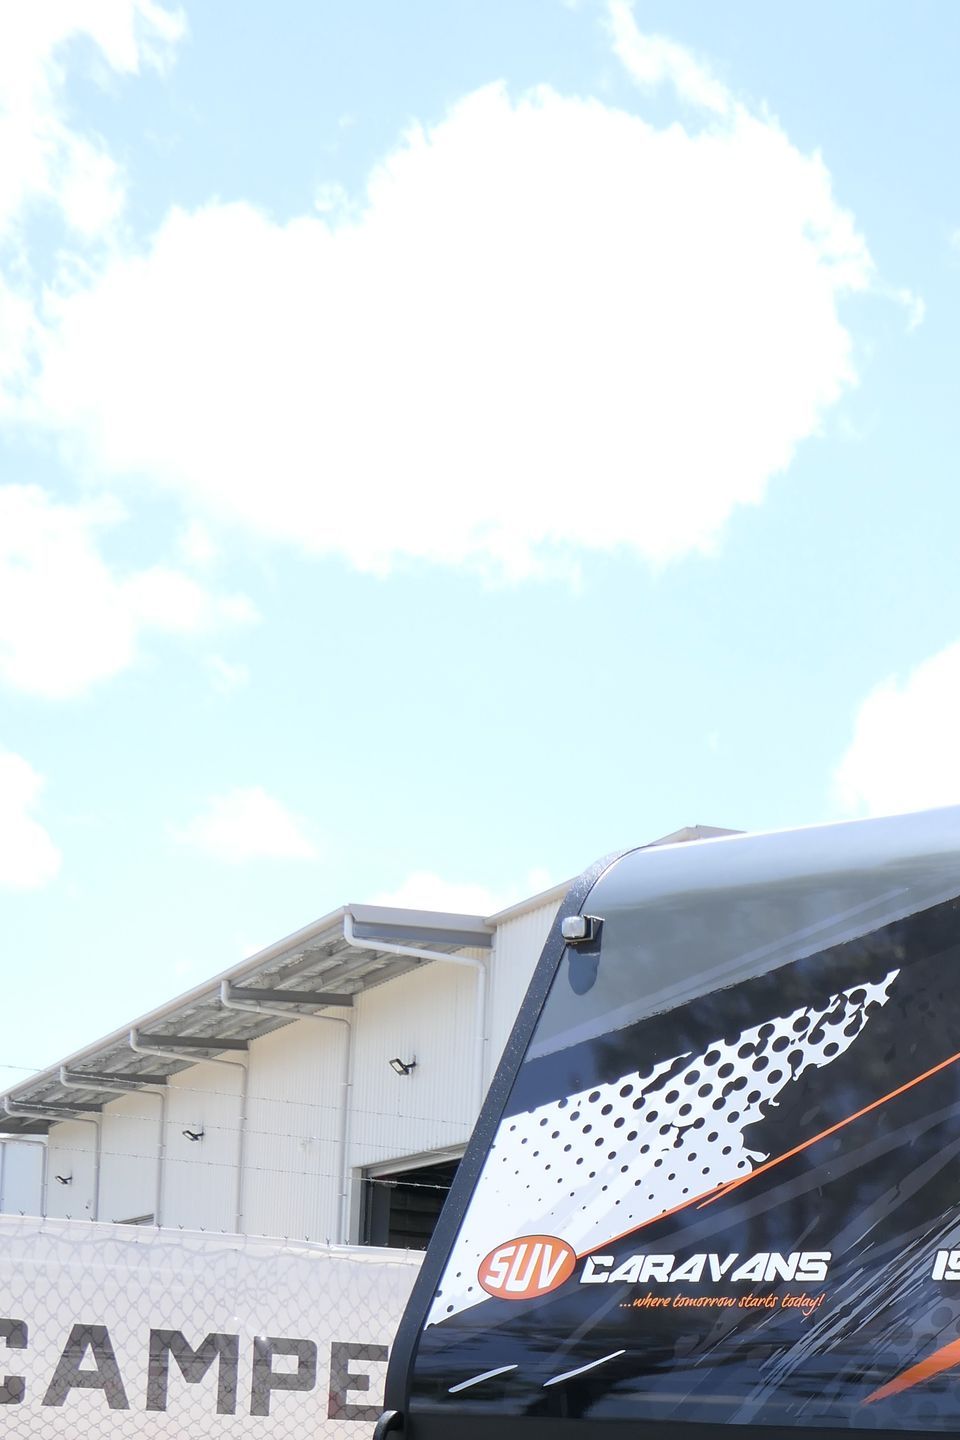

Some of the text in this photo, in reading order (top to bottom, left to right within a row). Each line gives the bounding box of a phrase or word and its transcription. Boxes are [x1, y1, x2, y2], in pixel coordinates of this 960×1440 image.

[485, 1243, 832, 1292] SUV CARAVANS
[672, 1293, 736, 1308] tomorrow
[738, 1293, 778, 1308] starts
[781, 1293, 824, 1316] today!
